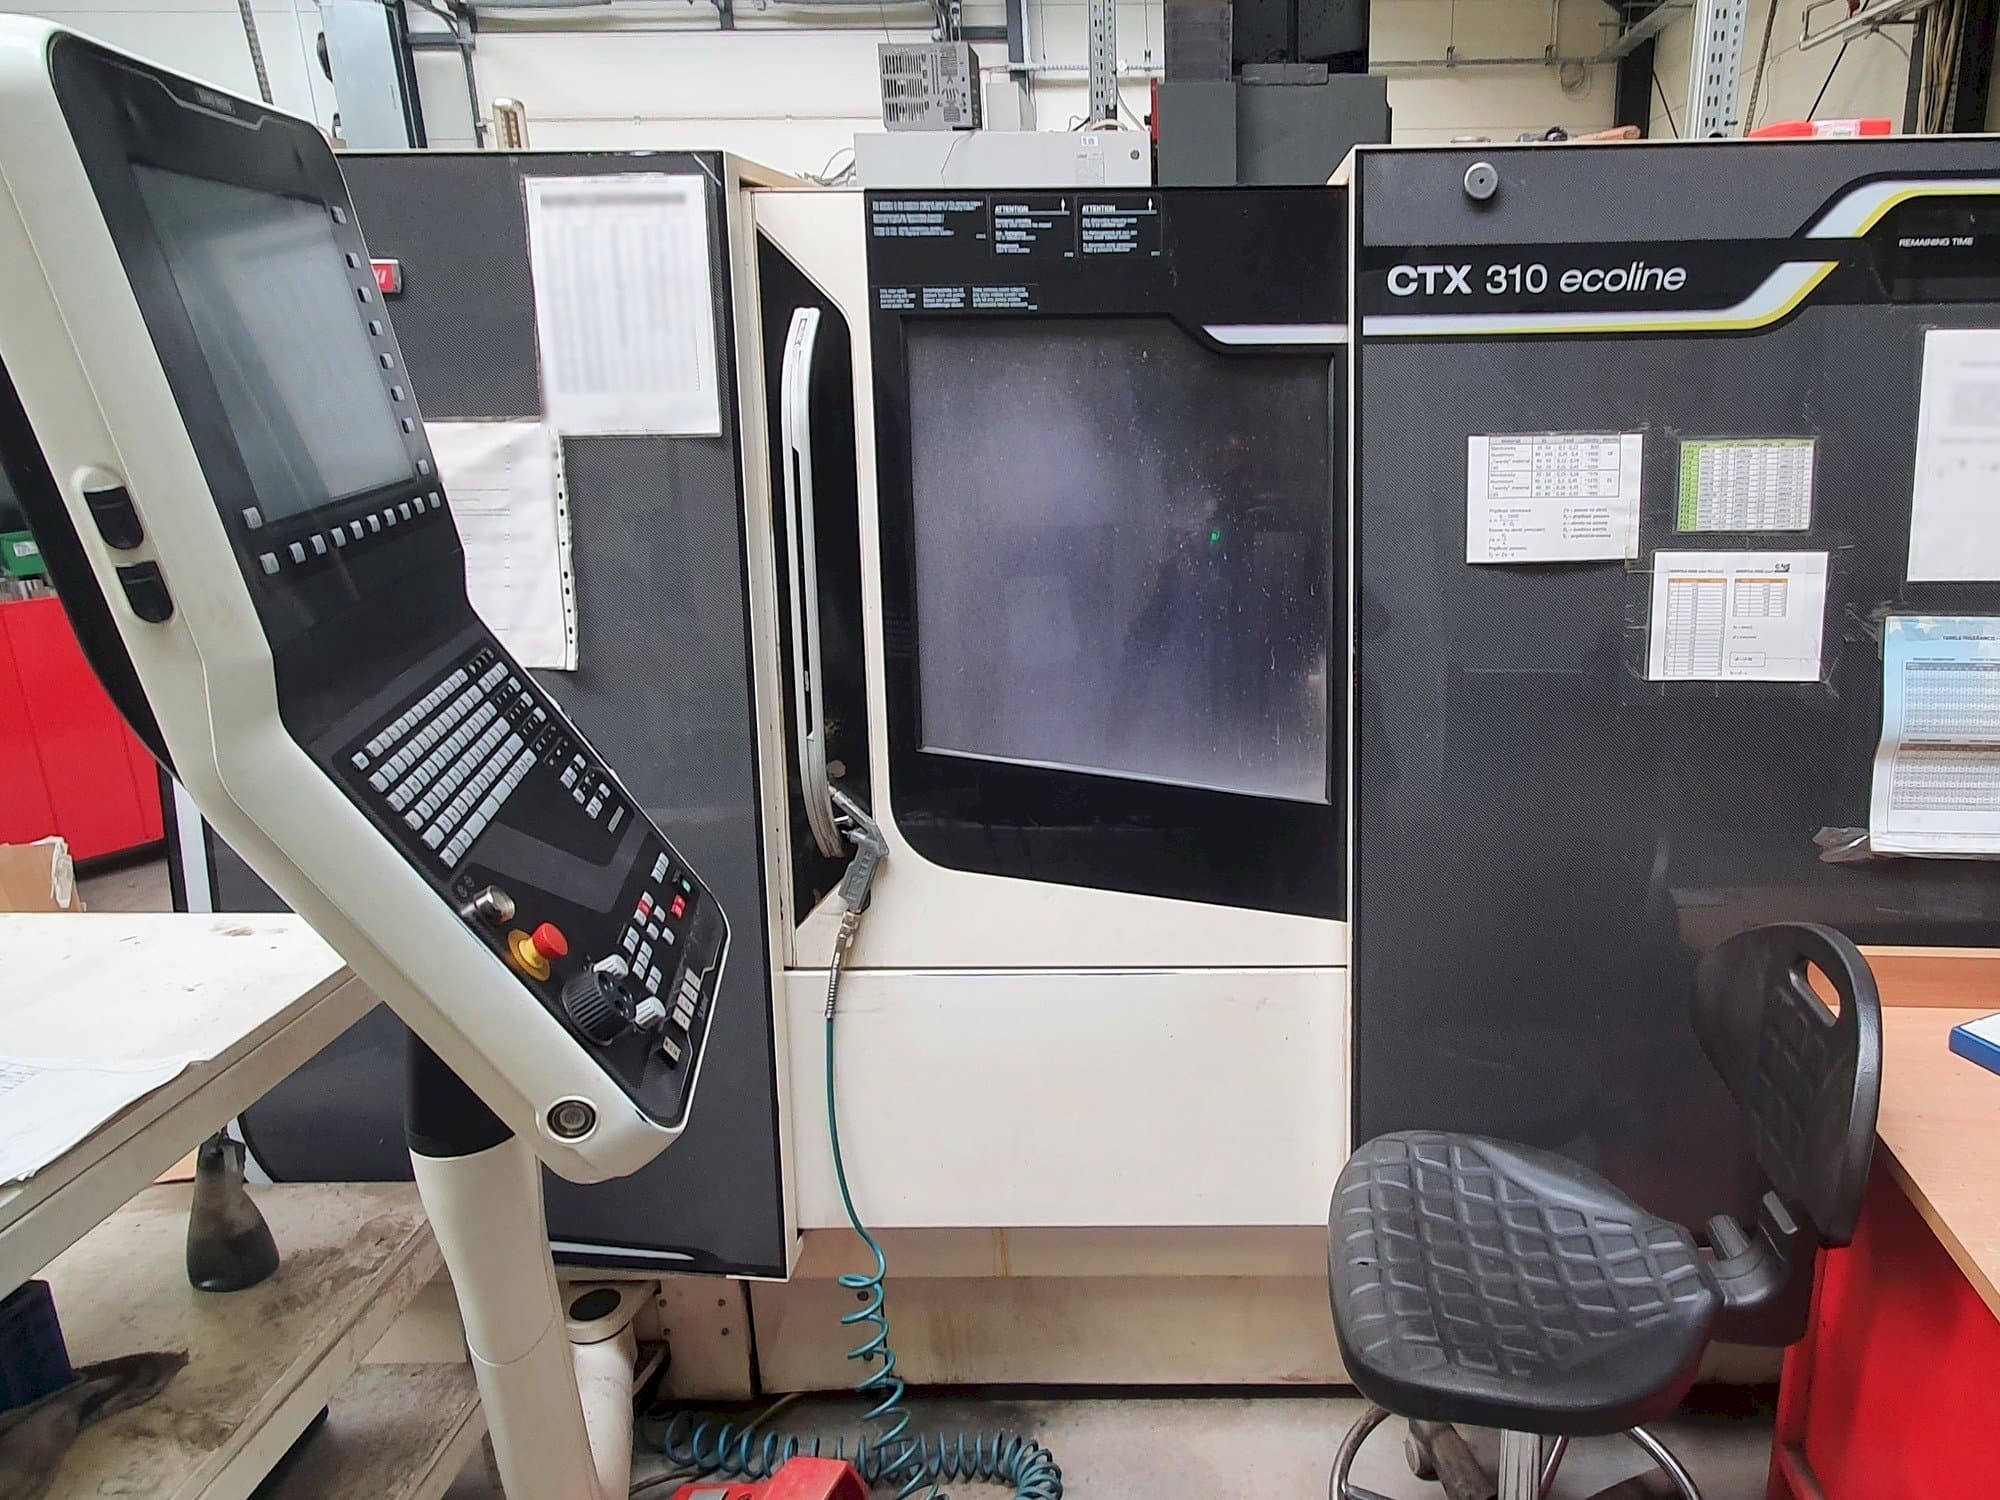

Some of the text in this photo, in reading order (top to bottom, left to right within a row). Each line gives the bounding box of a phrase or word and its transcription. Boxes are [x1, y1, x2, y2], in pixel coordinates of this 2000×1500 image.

[995, 205, 1029, 213] ATTENTION
[1082, 204, 1116, 213] ATTENTION
[1898, 236, 1974, 247] REMAINING TIME
[1387, 261, 1687, 296] CTX 310 ecoline
